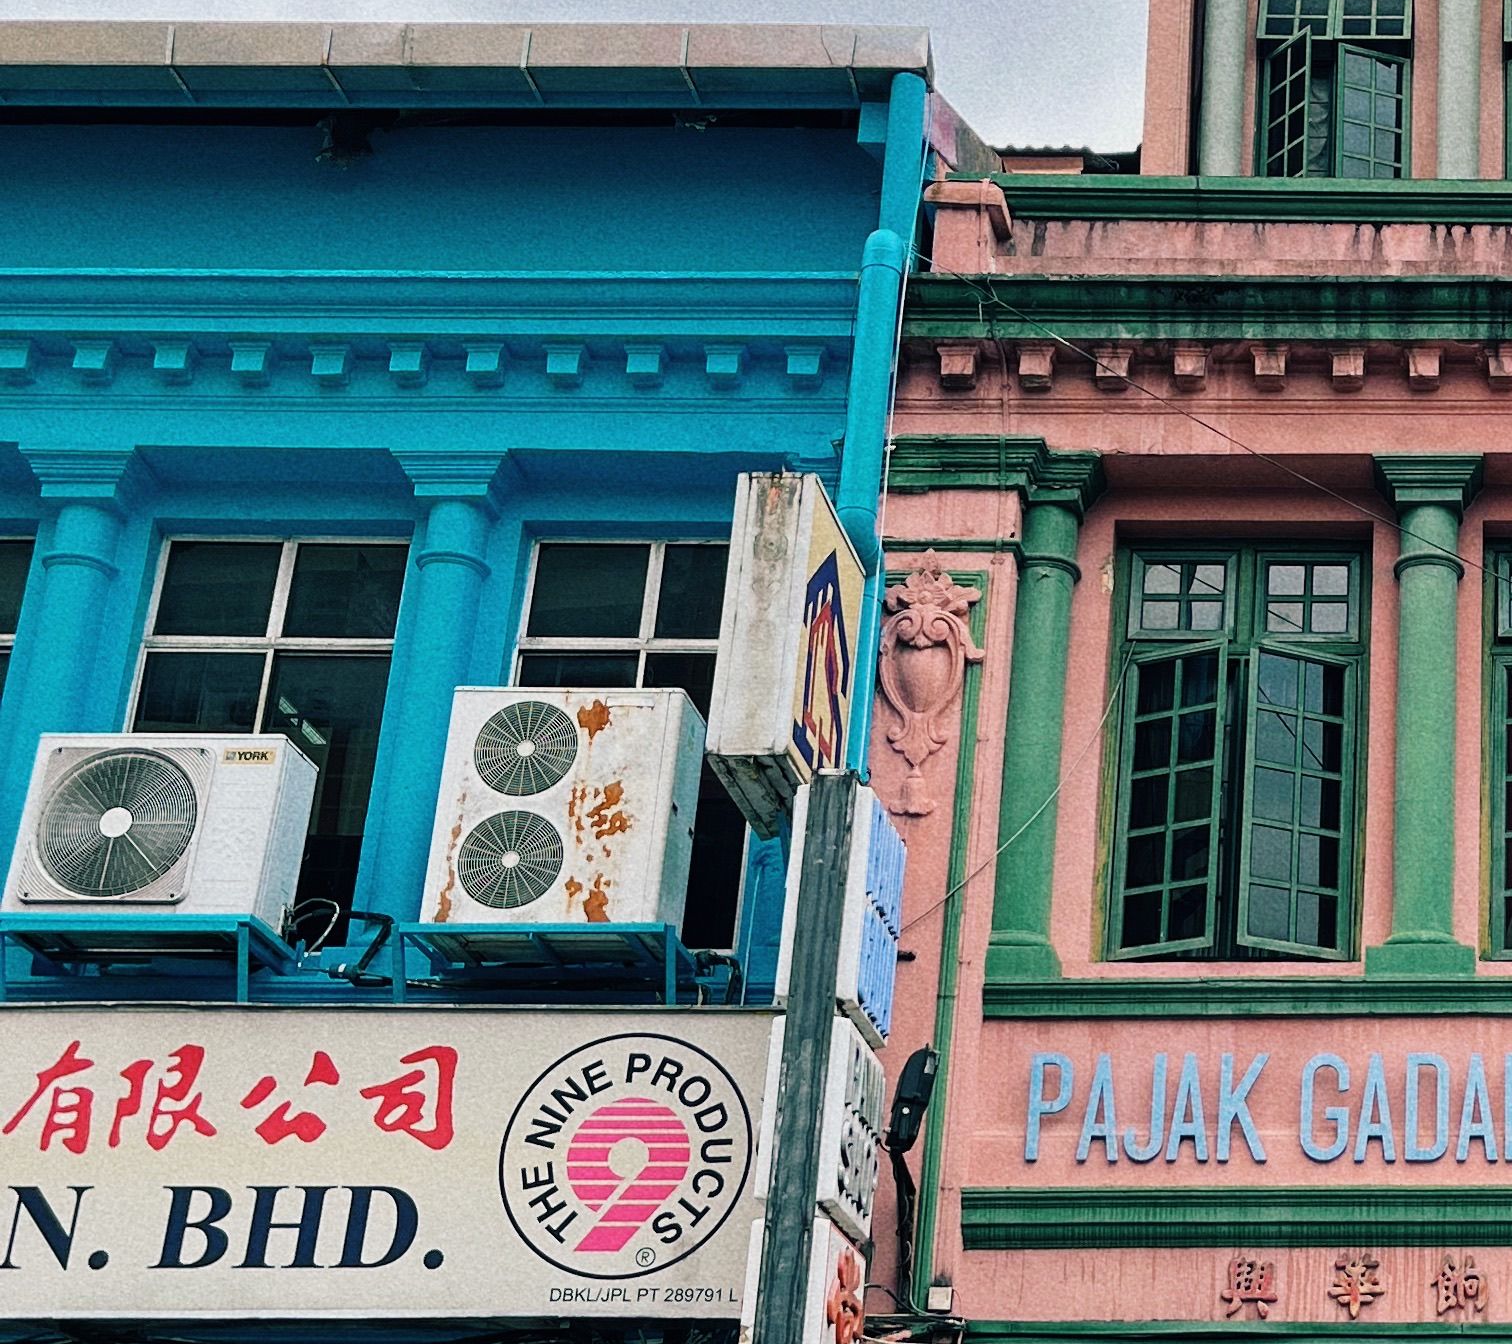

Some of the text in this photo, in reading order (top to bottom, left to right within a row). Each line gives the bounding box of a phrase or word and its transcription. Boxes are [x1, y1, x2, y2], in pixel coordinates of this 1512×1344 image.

[238, 751, 269, 761] YORK
[3, 1040, 458, 1154] 有限公司
[1024, 1052, 1269, 1164] PAJAK
[521, 1052, 734, 1244] THE NINE PRODUCTS
[147, 1186, 445, 1271] BHD.
[549, 1287, 739, 1304] DBKL/JPL PT 289791 L
